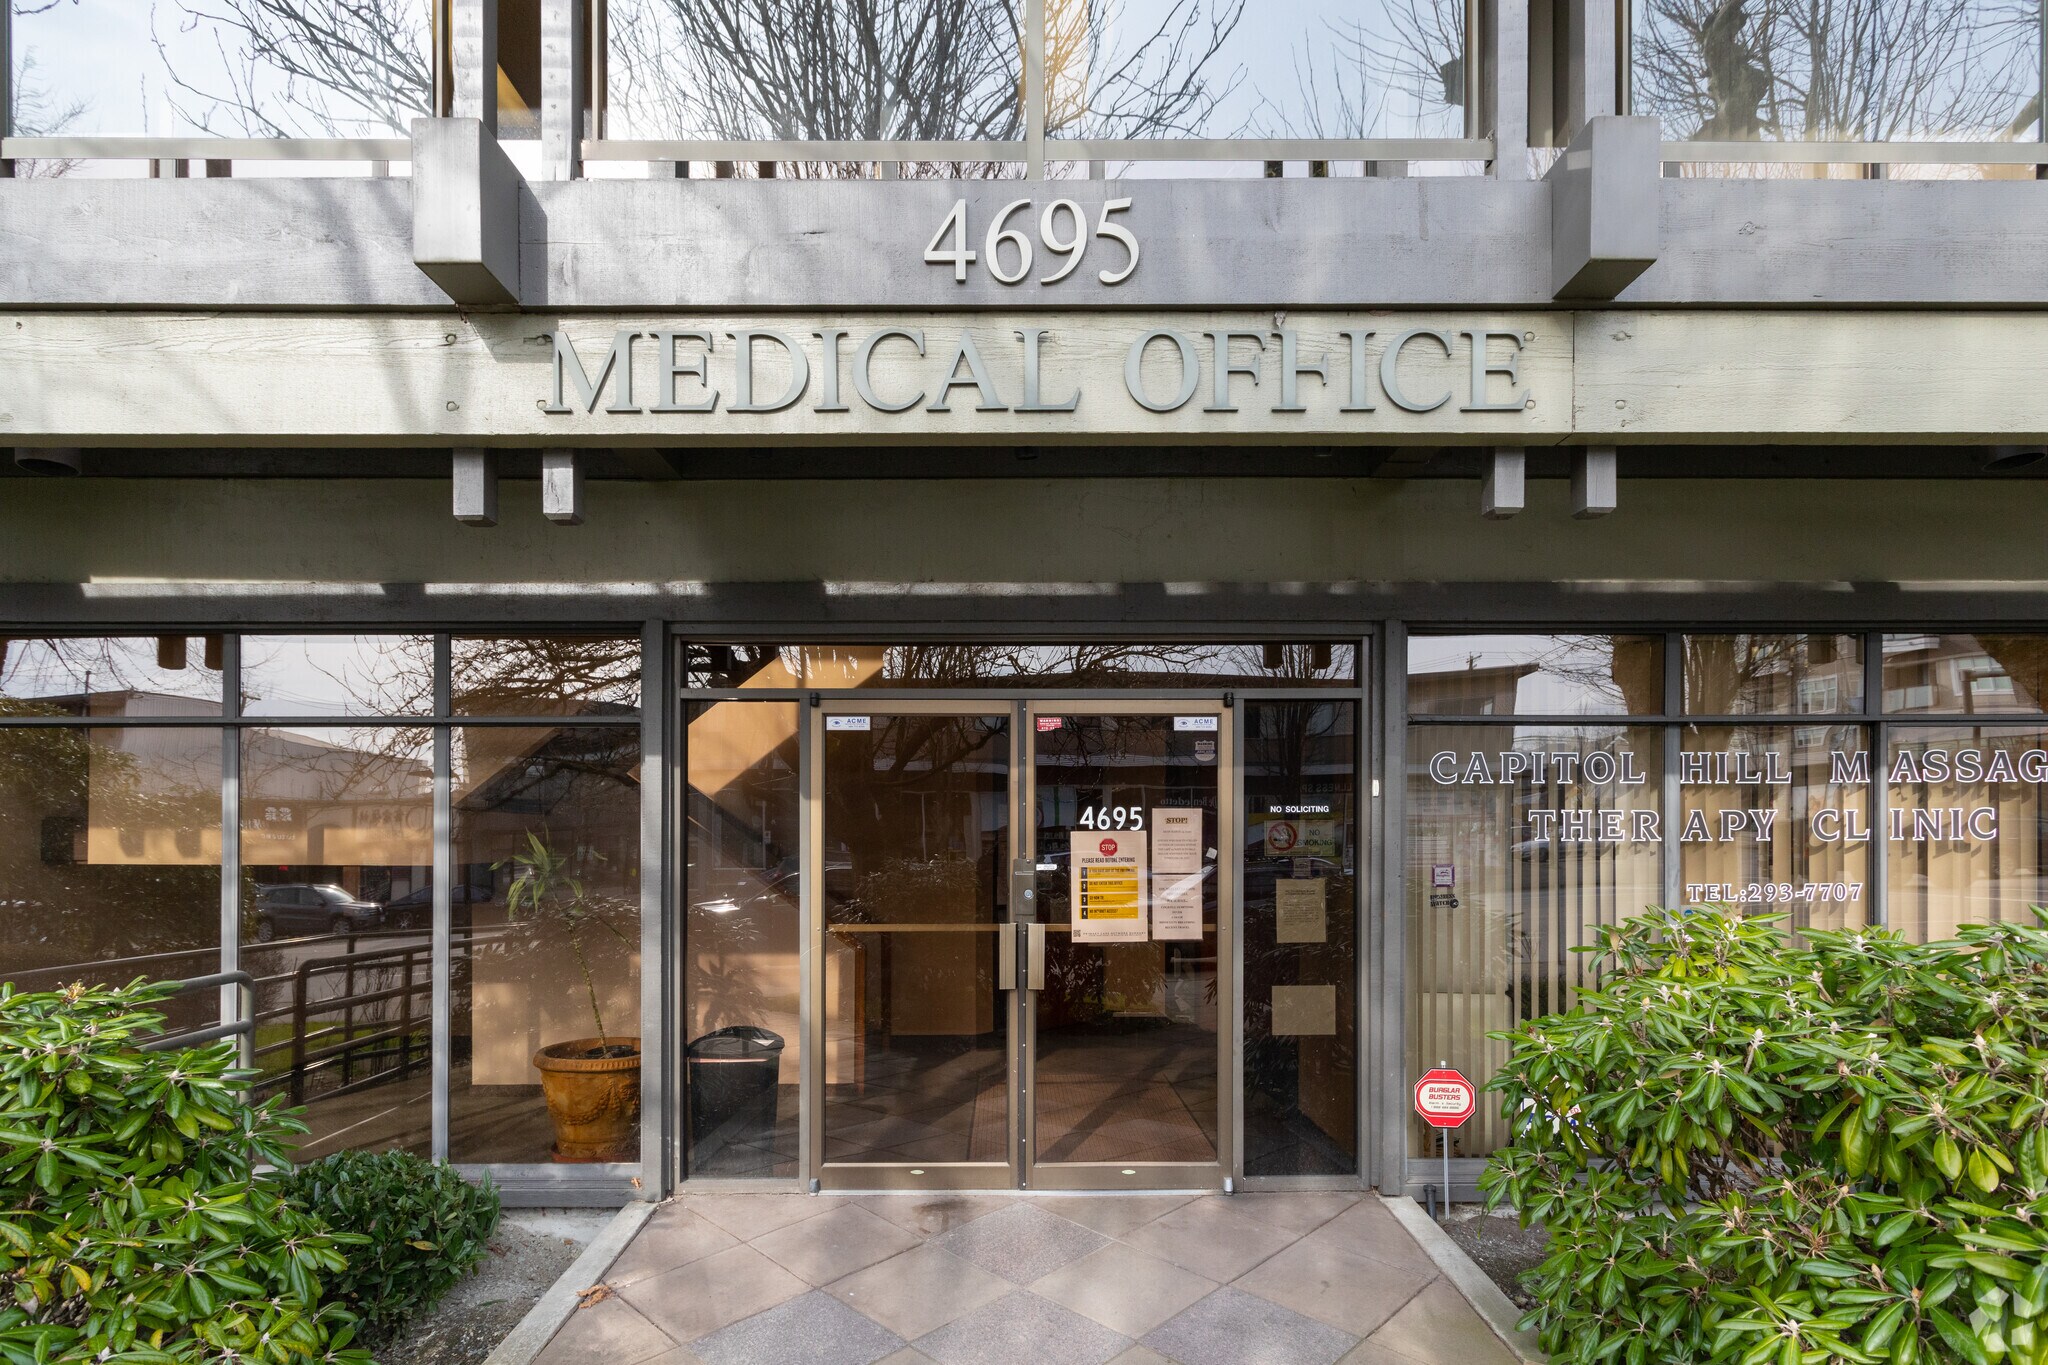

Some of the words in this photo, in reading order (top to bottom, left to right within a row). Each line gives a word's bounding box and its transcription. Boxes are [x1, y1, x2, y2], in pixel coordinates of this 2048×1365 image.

[923, 197, 1141, 286] 4695
[544, 328, 1082, 414] MEDICAL
[1124, 327, 1531, 414] OFFICE
[1429, 750, 1647, 785] CAPITOL
[1679, 750, 1793, 785] HILL
[1079, 806, 1143, 830] 4695
[1270, 805, 1282, 813] NO
[1285, 805, 1330, 813] SOLICITING
[1308, 828, 1320, 836] NO
[1528, 808, 1778, 842] THERAPY
[1811, 806, 1998, 842] CLINIC
[1101, 843, 1116, 851] STOP
[1685, 882, 1864, 903] TEL:293-7707
